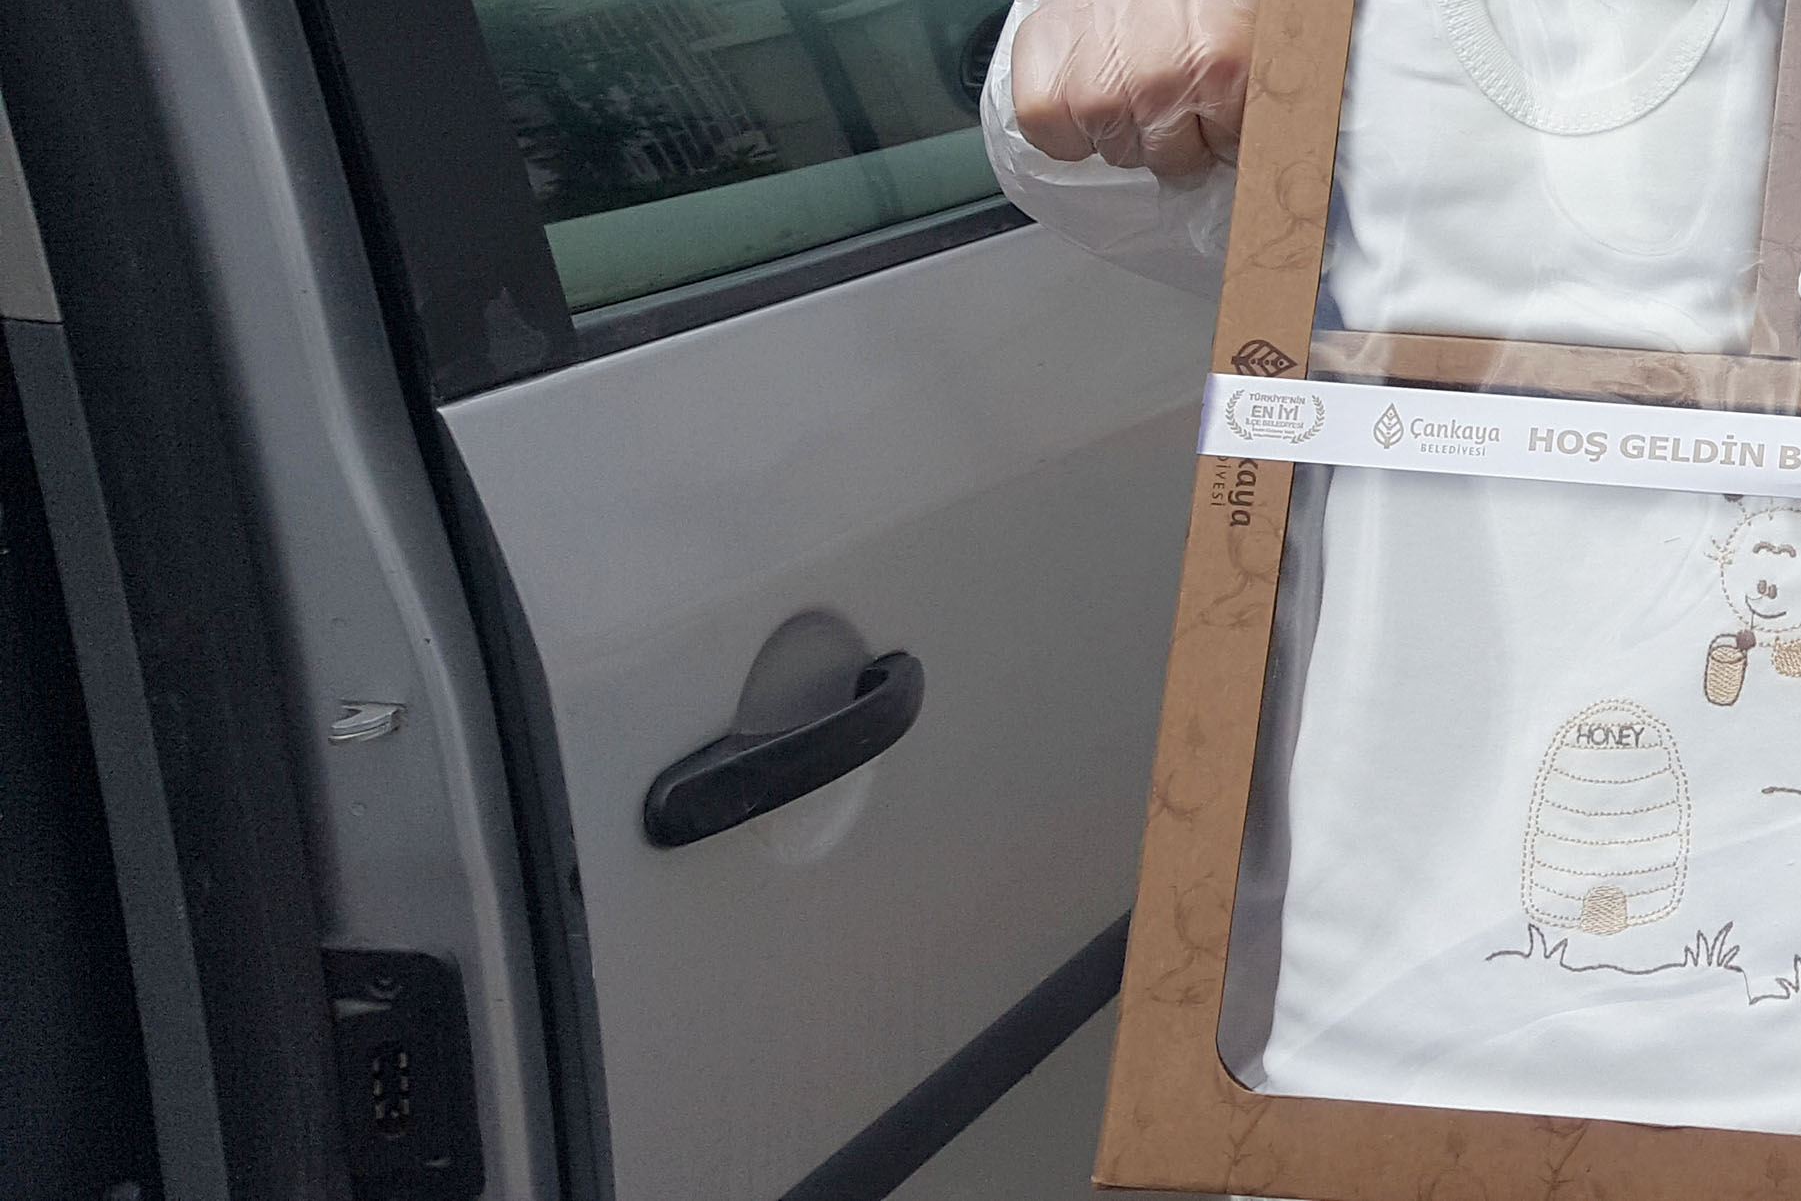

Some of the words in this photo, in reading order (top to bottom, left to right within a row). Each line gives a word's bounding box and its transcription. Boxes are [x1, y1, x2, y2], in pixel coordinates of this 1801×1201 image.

[1251, 404, 1274, 419] EN
[1278, 403, 1299, 421] İYİ
[1410, 418, 1500, 445] Çankaya
[1420, 443, 1486, 457] BELEDİYESİ
[1528, 426, 1606, 464] HOŞ
[1619, 429, 1767, 470] GELDİN
[1577, 724, 1645, 748] HONEY
